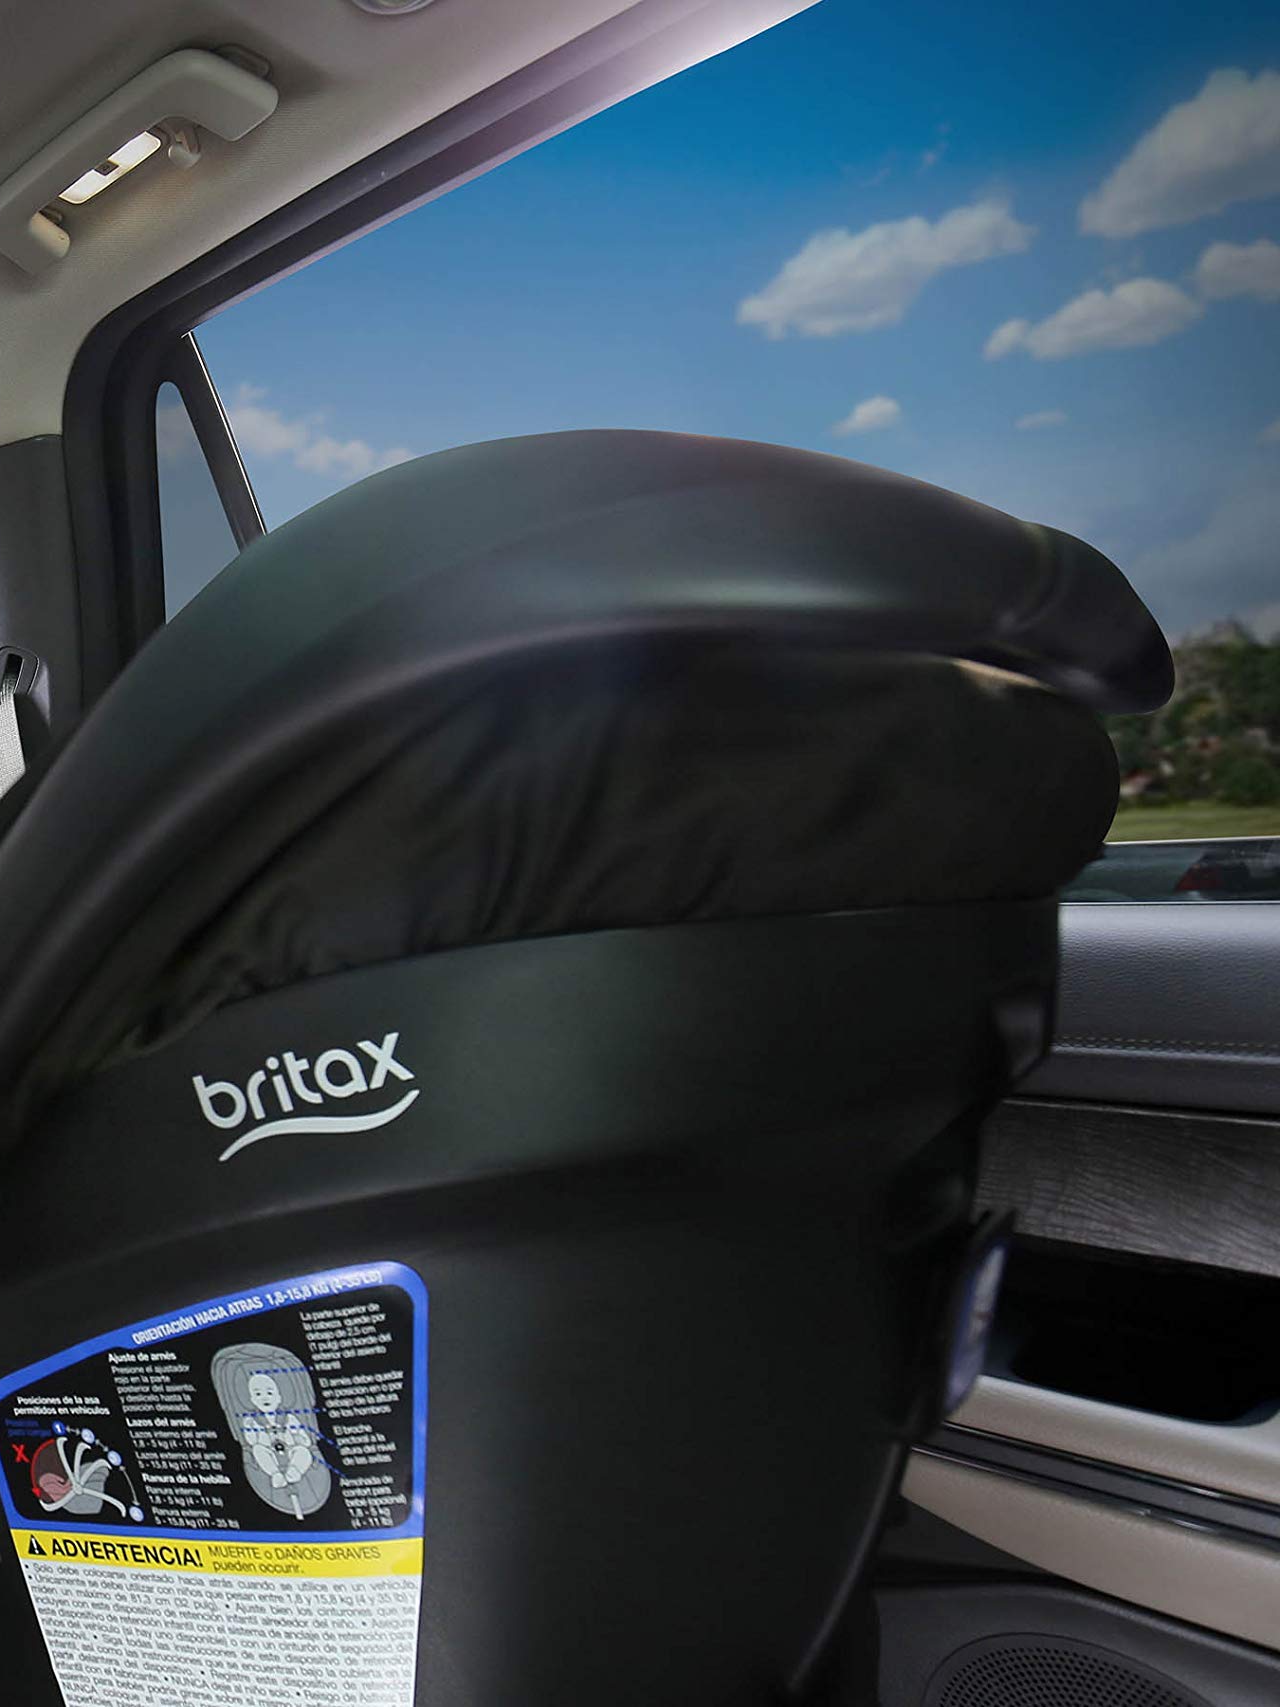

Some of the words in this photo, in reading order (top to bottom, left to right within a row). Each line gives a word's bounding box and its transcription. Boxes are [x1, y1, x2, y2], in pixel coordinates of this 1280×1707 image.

[192, 1032, 415, 1129] britax
[132, 1316, 196, 1345] ORIENTACIÓN
[195, 1306, 229, 1326] HACIA
[108, 1352, 136, 1364] Ajuste
[137, 1352, 149, 1361] de
[17, 1396, 61, 1405] Posiciones
[62, 1396, 73, 1404] de
[74, 1396, 83, 1404] la
[154, 1418, 169, 1426] del
[142, 1473, 175, 1483] Ranura
[175, 1475, 188, 1483] de
[188, 1474, 199, 1483] la
[52, 1538, 204, 1567] ADVERTENCIA!
[208, 1546, 261, 1560] MUERTE
[264, 1551, 273, 1560] o
[275, 1545, 323, 1561] DAÑOS
[324, 1546, 381, 1561] GRAVES
[213, 1560, 258, 1573] pueden
[57, 1566, 80, 1576] debe
[83, 1569, 127, 1580] colocarse
[130, 1571, 175, 1584] orientado
[177, 1575, 205, 1586] hacia
[237, 1580, 276, 1591] cuando
